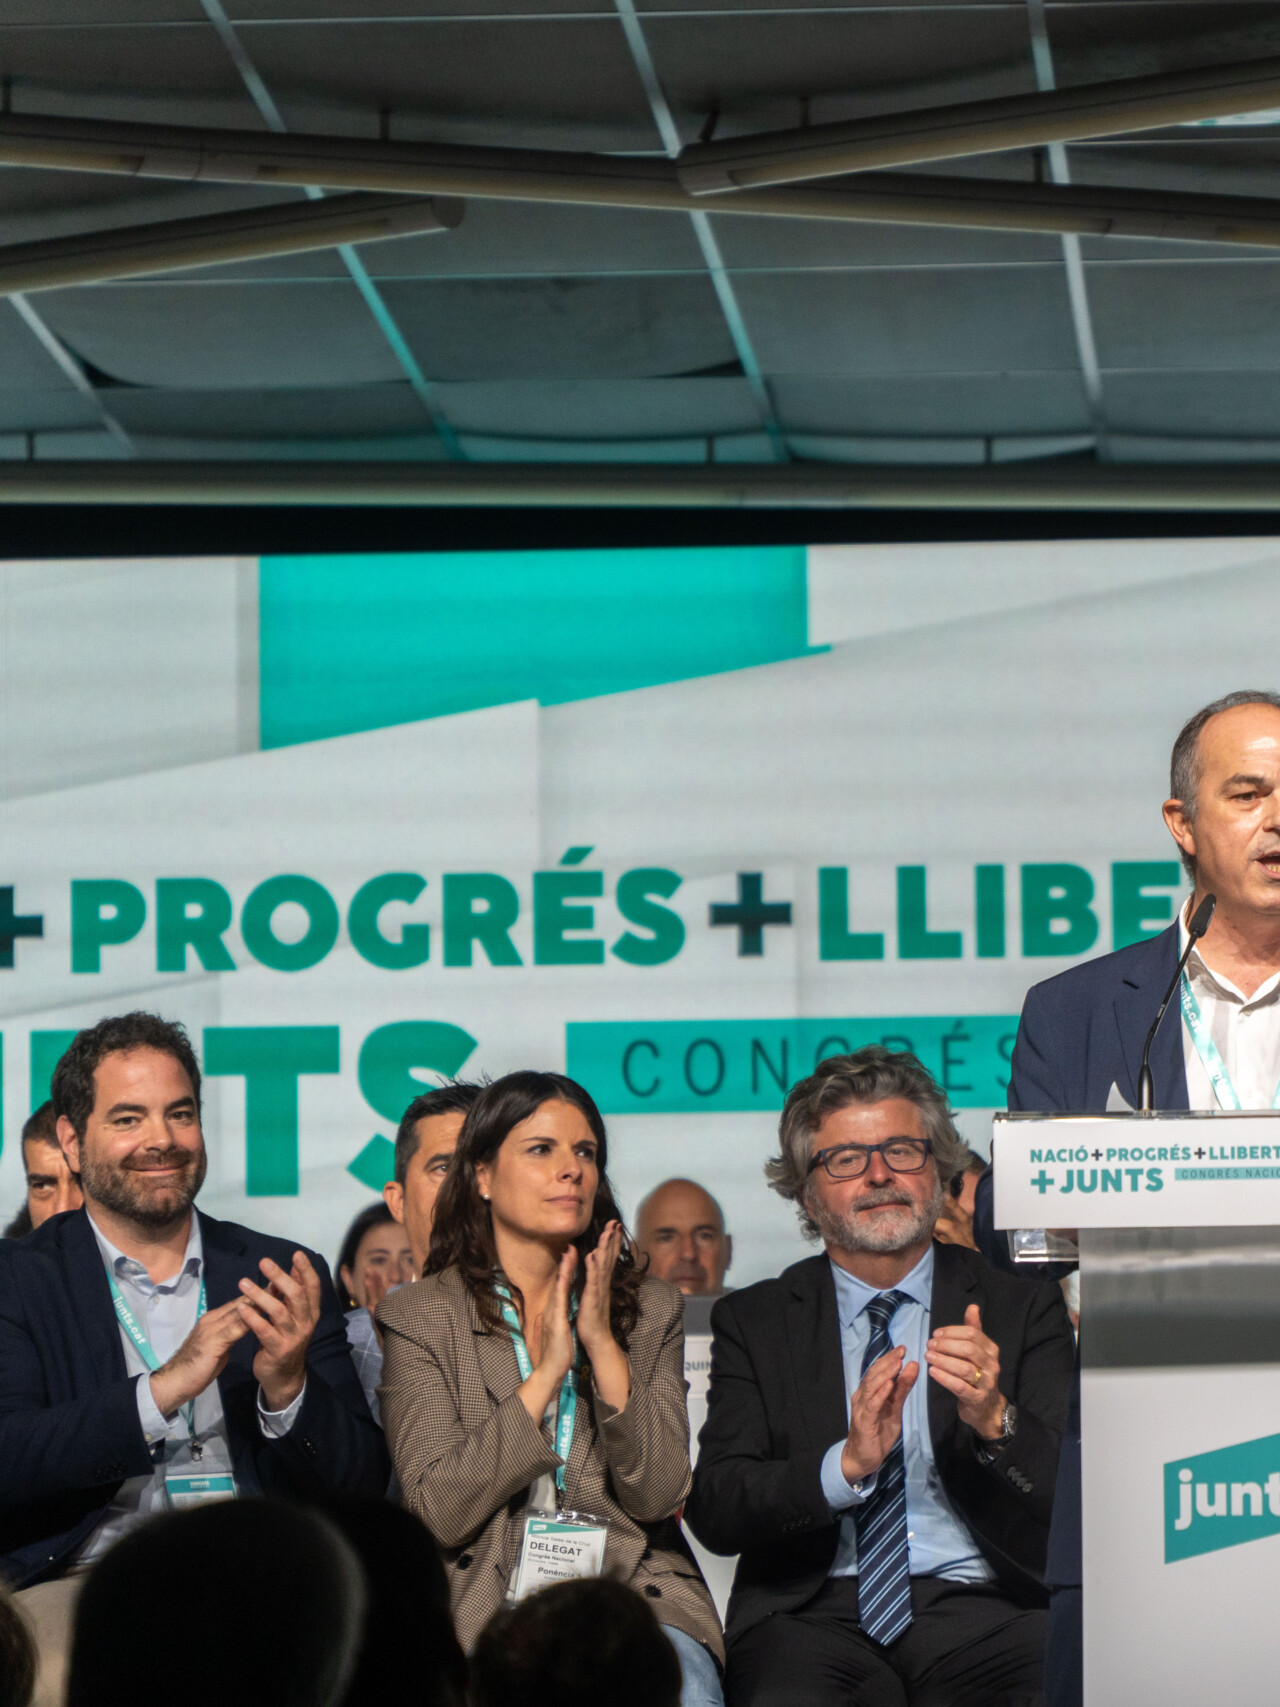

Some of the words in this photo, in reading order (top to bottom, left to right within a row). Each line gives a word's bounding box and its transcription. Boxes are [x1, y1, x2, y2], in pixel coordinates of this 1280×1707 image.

[71, 846, 686, 973] PROGRÉS
[1030, 1145, 1088, 1163] NACIÓ
[1106, 1143, 1191, 1162] PROGRÉS
[1181, 1167, 1240, 1180] CONGRÉS
[529, 1541, 583, 1557] DELEGAT
